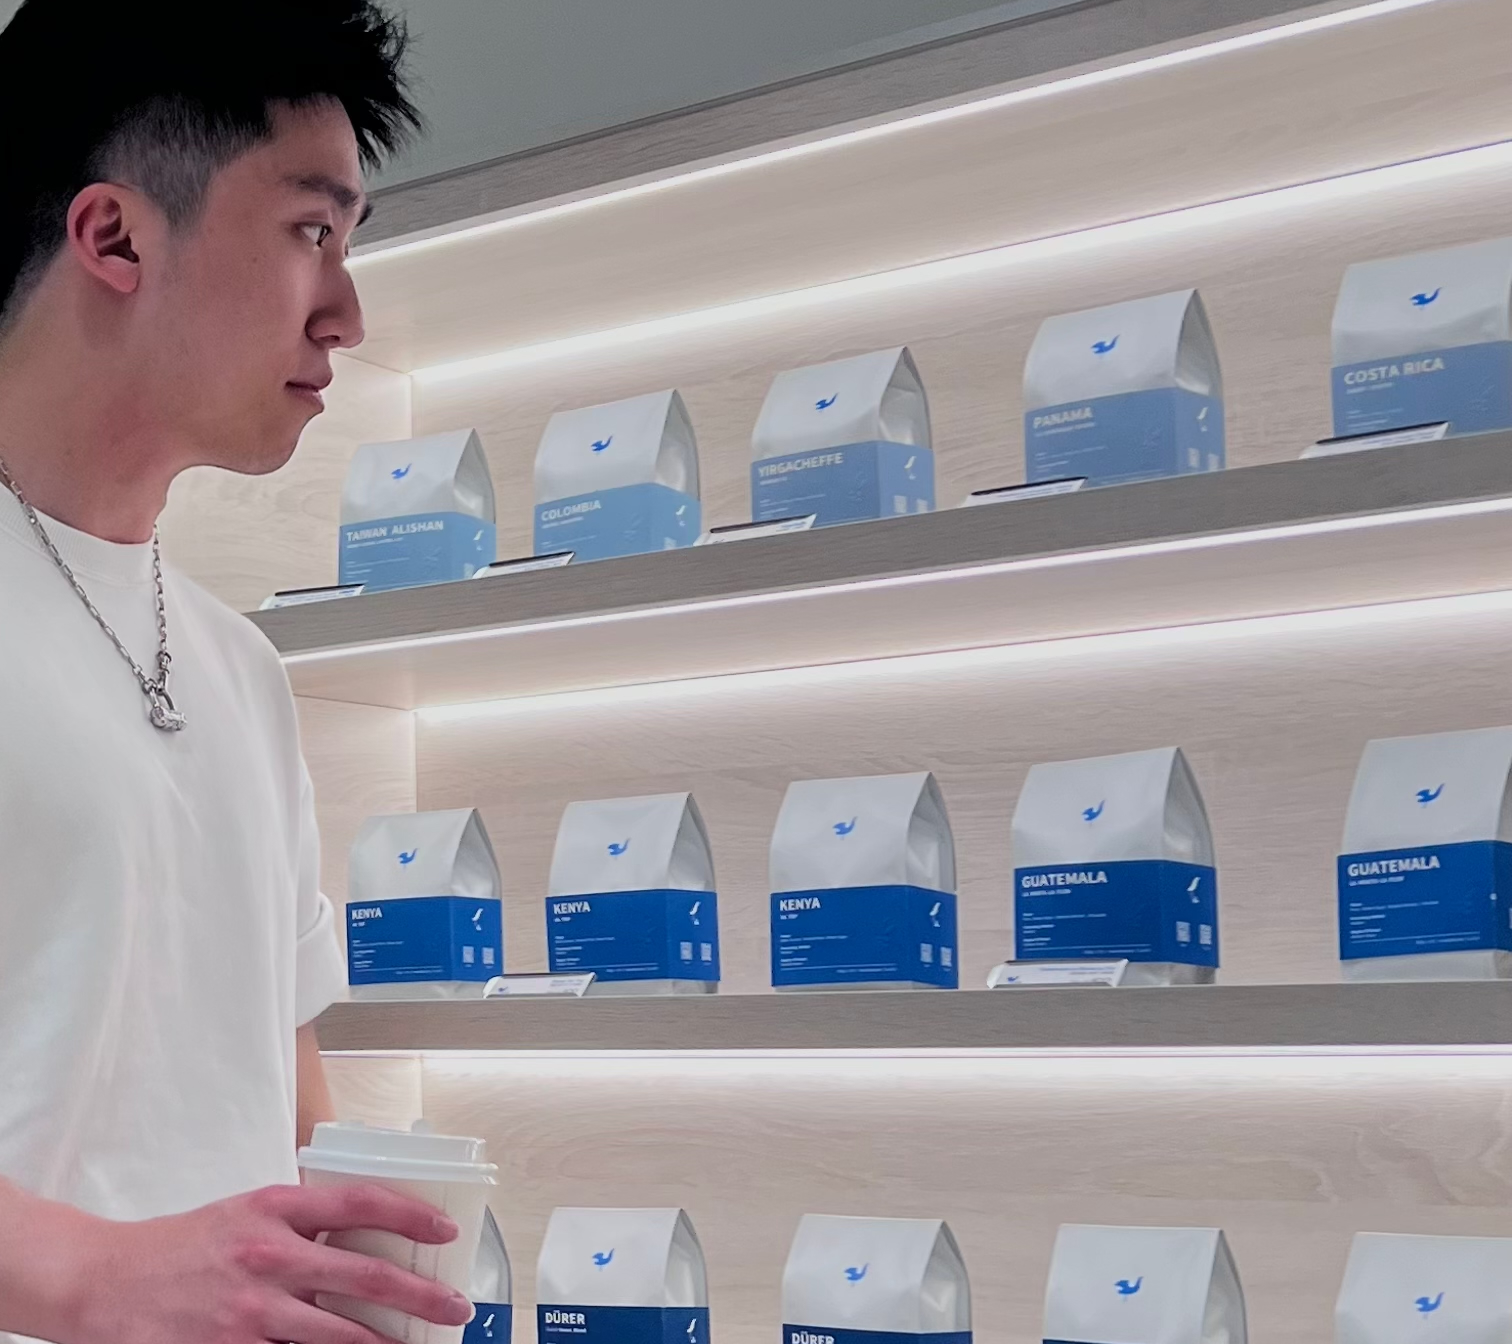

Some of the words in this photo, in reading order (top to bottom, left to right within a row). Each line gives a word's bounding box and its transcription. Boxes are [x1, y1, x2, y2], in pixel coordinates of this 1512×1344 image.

[1344, 365, 1400, 385] COSTA
[1403, 357, 1445, 376] RICA
[1033, 407, 1093, 429] PANAMA
[758, 452, 844, 477] YIRGACHEFFE
[541, 500, 602, 522] COLOMBIA
[346, 527, 387, 542] TAIWAN
[392, 520, 444, 535] ALISHAN
[1347, 855, 1440, 877] GUATEMALA
[1022, 871, 1107, 888] GUATEMALA
[352, 908, 382, 920] KENYA
[554, 902, 590, 914] KENYA
[780, 898, 820, 911] KENYA
[545, 1309, 586, 1325] DÜRER
